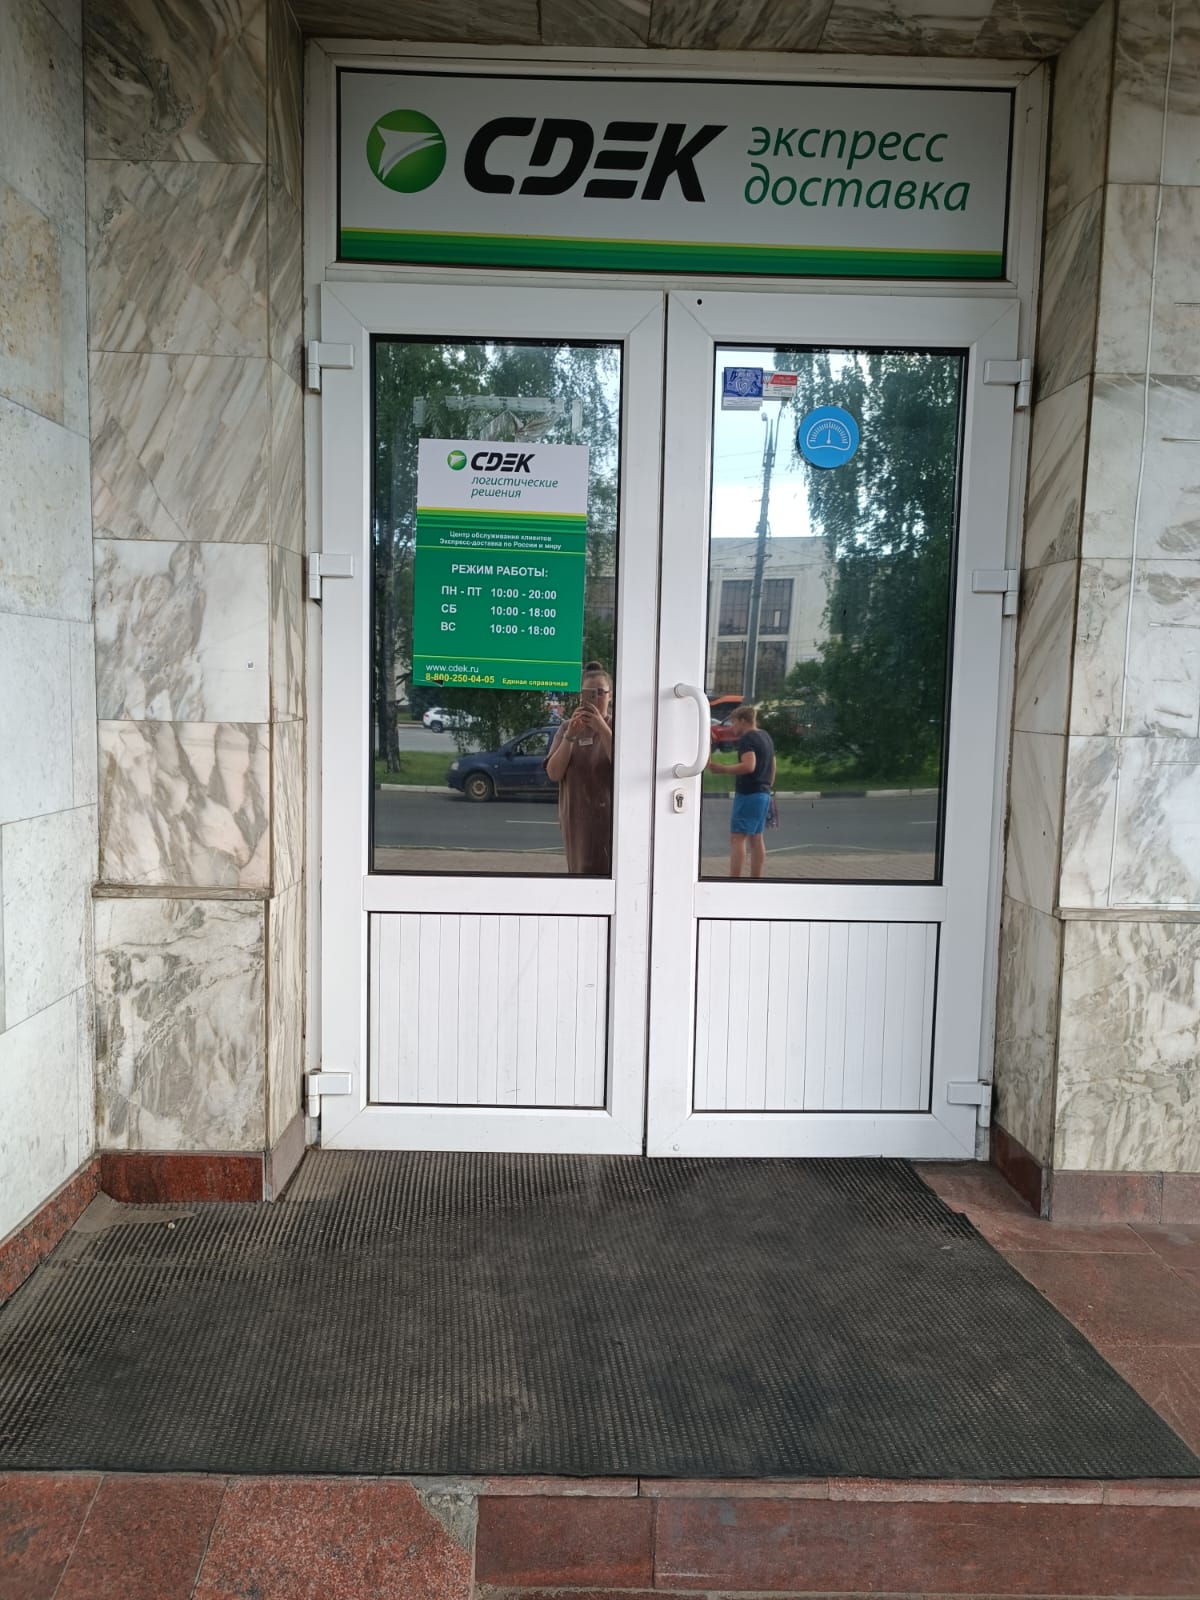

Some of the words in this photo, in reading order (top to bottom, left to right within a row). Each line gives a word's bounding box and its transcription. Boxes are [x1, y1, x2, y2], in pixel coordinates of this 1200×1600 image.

[747, 125, 948, 169] экспресс
[464, 116, 728, 203] CDEK
[744, 162, 971, 211] доставка
[470, 451, 535, 473] CDEK
[471, 475, 559, 488] логистические
[470, 487, 522, 499] решения
[449, 531, 470, 539] Центр
[451, 564, 493, 575] РЕЖИМ
[496, 566, 549, 578] РАБОТЫ:
[441, 586, 458, 596] ПН
[467, 587, 482, 597] ПТ
[490, 588, 519, 599] 10:00
[528, 589, 557, 600] 20:00
[441, 604, 457, 614] СБ
[490, 606, 519, 617] 10:00
[528, 607, 557, 618] 18:00
[440, 622, 456, 632] ВС
[490, 624, 518, 634] 10:00
[527, 626, 556, 636] 18:00
[425, 663, 479, 673] www.cdek.ru
[425, 672, 495, 684] 8-800-250-04-05
